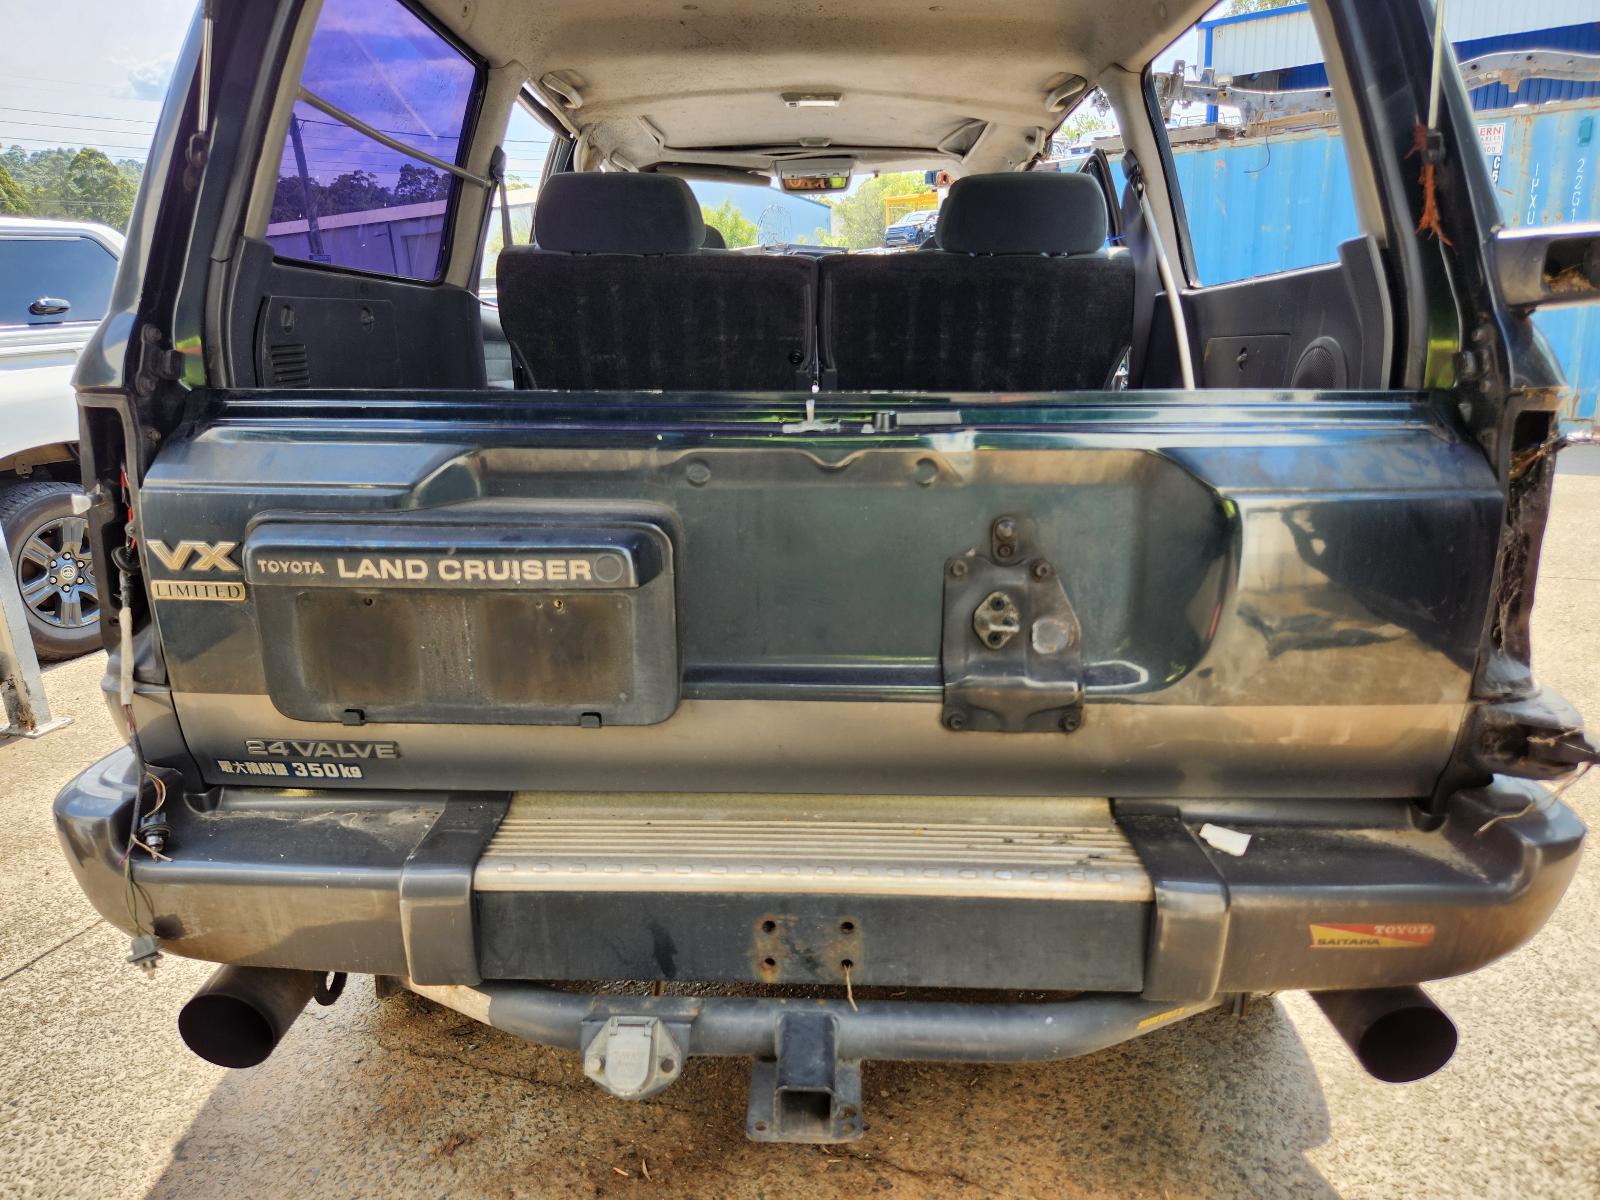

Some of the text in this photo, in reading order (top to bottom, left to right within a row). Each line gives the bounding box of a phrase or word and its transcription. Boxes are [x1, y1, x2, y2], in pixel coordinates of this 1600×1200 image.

[1571, 158, 1585, 223] 22G1
[147, 540, 240, 572] VX
[257, 558, 592, 581] TOYOTA LAND CRUISER
[156, 583, 241, 599] LIMITED
[1317, 938, 1380, 946] SAITAMA
